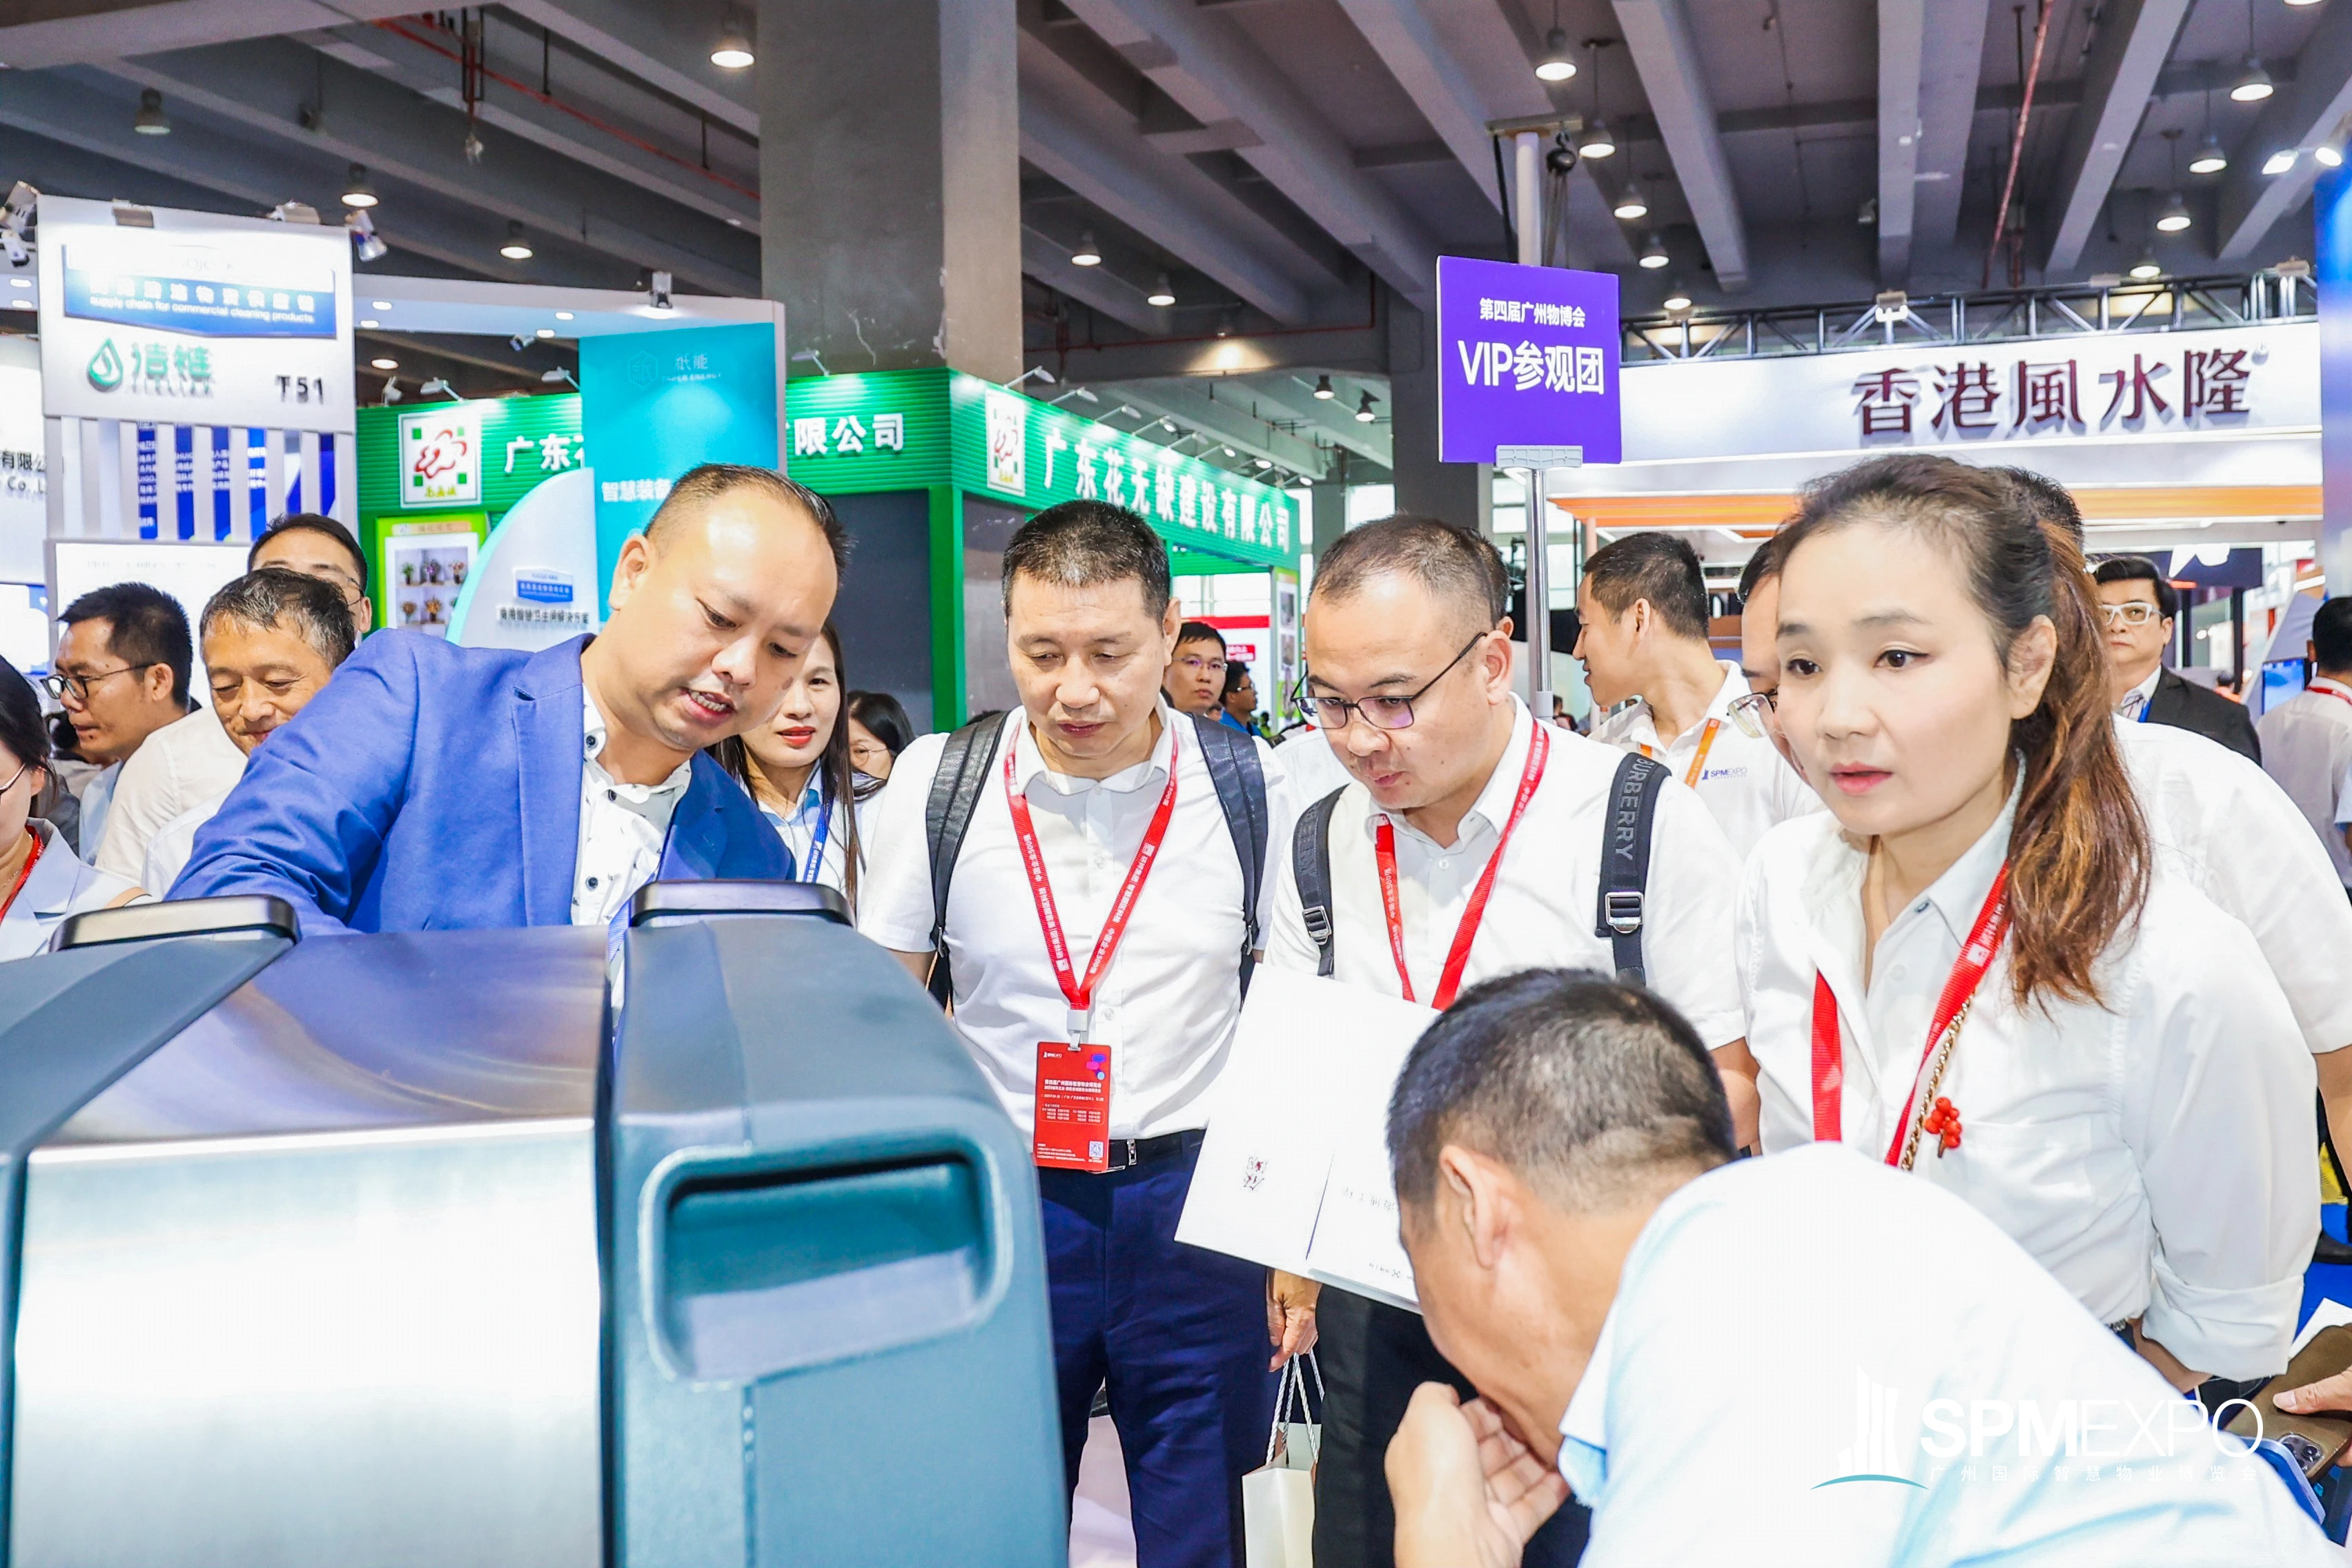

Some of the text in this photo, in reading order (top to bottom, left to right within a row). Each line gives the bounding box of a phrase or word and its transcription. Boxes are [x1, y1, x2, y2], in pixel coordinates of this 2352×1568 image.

[155, 301, 170, 311] for
[172, 304, 228, 317] commercial
[231, 307, 271, 322] cleaning
[272, 311, 315, 324] products
[1480, 297, 1586, 328] 第四届广州物博会
[276, 375, 324, 399] T51
[1458, 340, 1605, 395] VIP参观团
[1854, 348, 2251, 435] 香港風水隆
[786, 413, 903, 456] 限公司
[1043, 427, 1290, 554] 广东花无缺建设有限公司
[1710, 767, 1747, 777] SPMEXPO
[1616, 758, 1655, 861] BURBERRY
